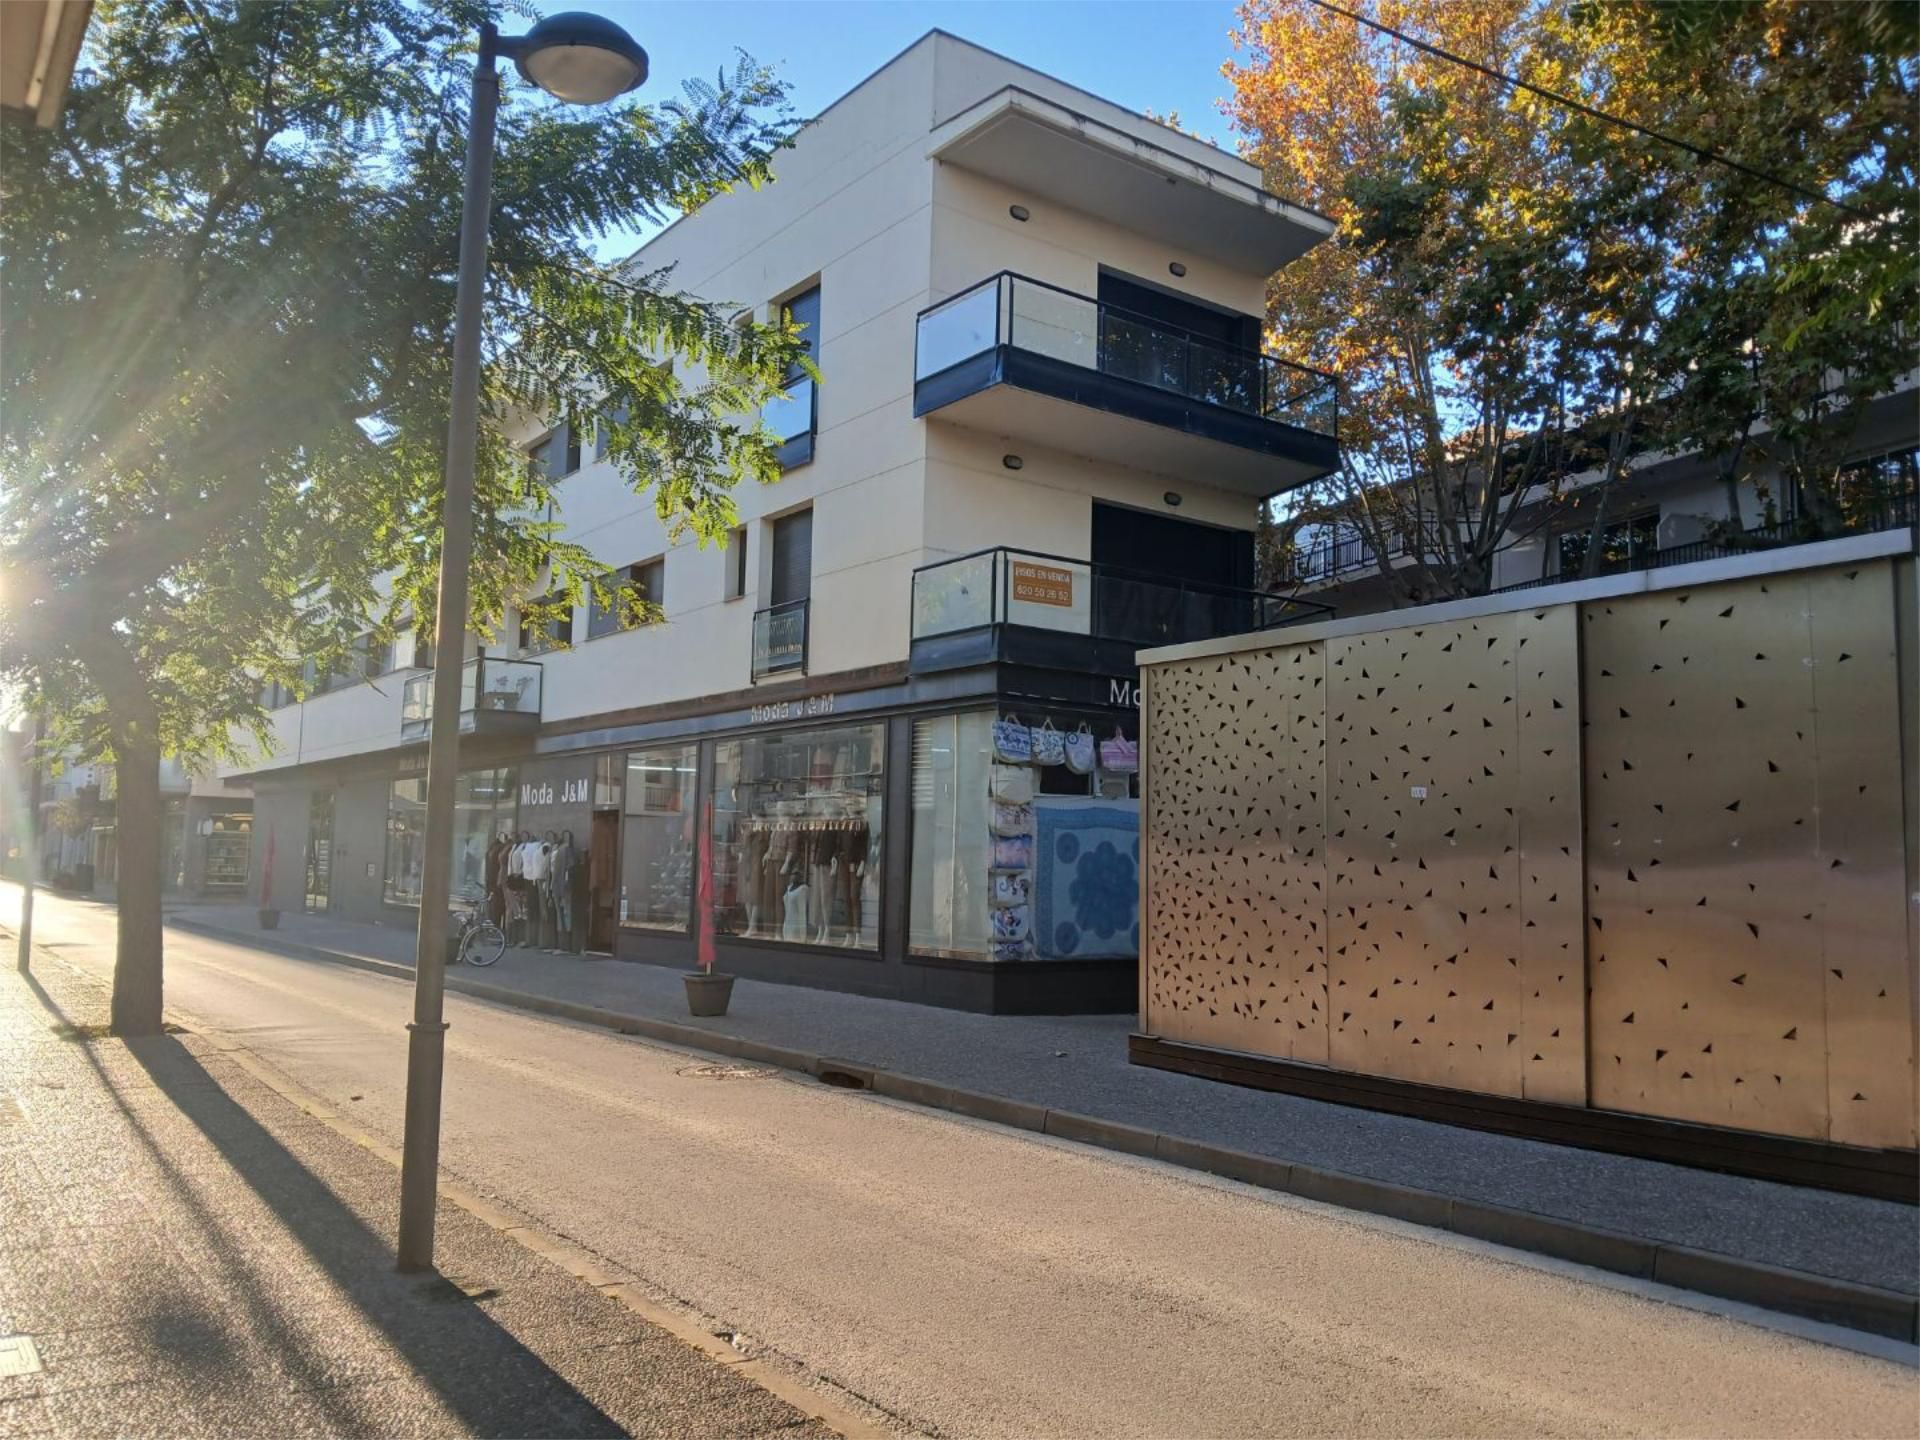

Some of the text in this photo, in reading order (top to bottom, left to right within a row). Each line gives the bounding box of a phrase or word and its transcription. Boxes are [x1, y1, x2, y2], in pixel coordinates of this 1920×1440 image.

[1015, 566, 1071, 584] PISOS EN VENDA
[751, 701, 789, 723] Moda
[521, 778, 588, 806] Moda J&M
